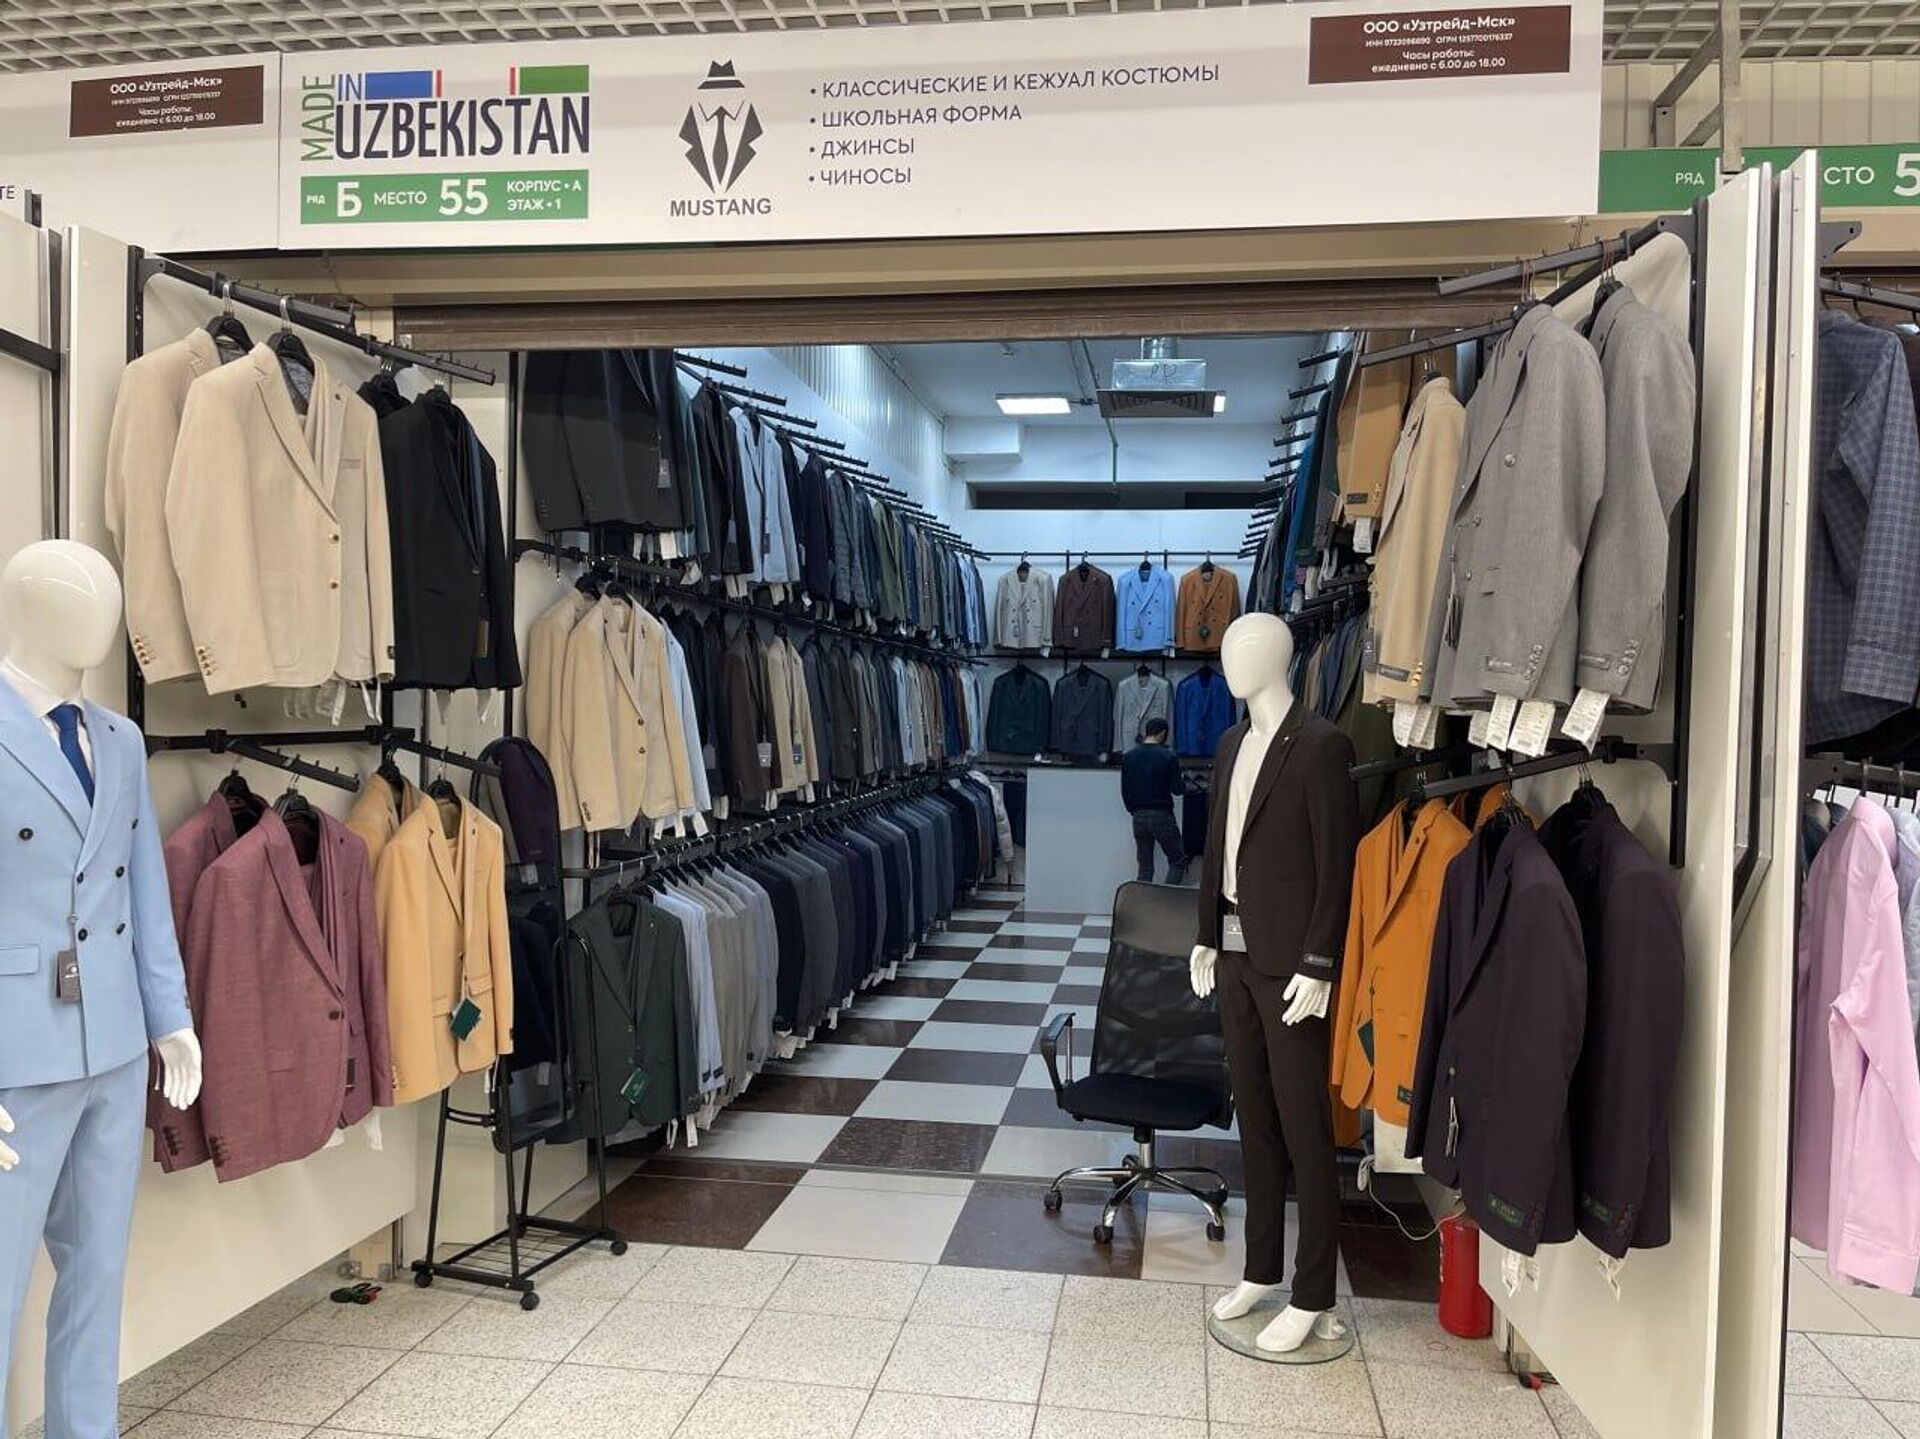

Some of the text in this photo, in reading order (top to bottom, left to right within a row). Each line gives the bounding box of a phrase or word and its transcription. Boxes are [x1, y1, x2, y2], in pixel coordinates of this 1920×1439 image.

[1363, 20, 1399, 34] ООО
[1435, 35, 1457, 45] ОГРН
[1371, 57, 1506, 73] ежедневно с 6.00 до 18.00
[1402, 51, 1430, 60] Часы
[109, 83, 137, 94] ООО
[338, 73, 362, 101] IN
[822, 64, 1220, 99] КЛАССИЧЕСКИЕ И КЕЖУАЛ КОСТЮМЫ
[138, 108, 160, 116] Часы
[301, 74, 336, 162] MADE
[822, 104, 1022, 128] ШКОЛЬНАЯ ФОРМА
[335, 96, 590, 160] UZBEKISTAN
[821, 138, 915, 159] ДЖИНСЫ
[820, 167, 912, 186] ЧИНОСЫ
[1675, 171, 1705, 186] РЯД
[1823, 166, 1875, 185] СТО
[506, 179, 582, 193] КОРПУС А
[336, 181, 363, 218] Б
[373, 191, 428, 206] МЕСТО
[438, 178, 487, 216] 55
[507, 197, 562, 210] ЭТАЖ 1
[669, 197, 772, 217] MUSTANG
